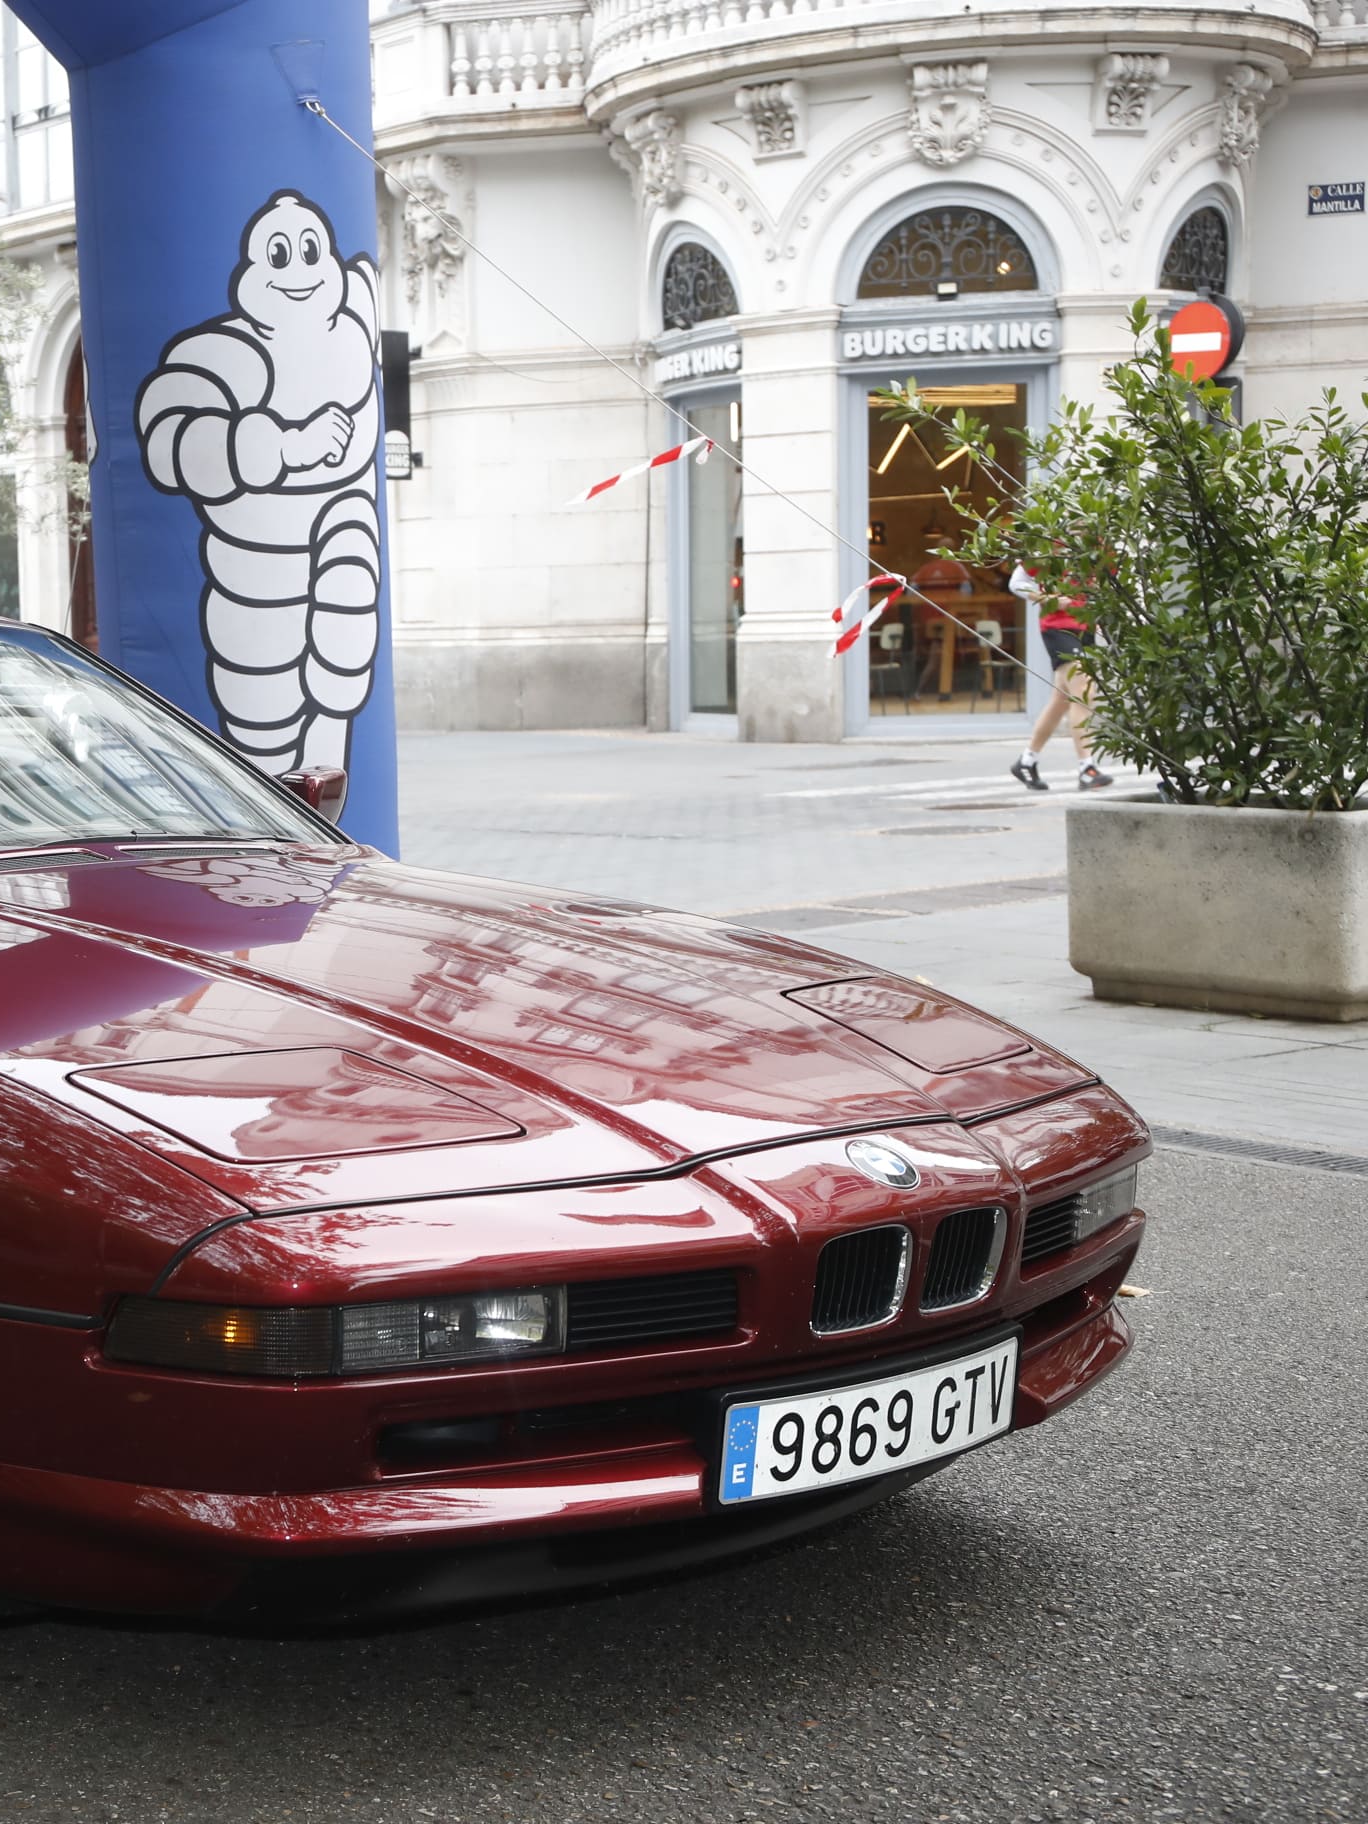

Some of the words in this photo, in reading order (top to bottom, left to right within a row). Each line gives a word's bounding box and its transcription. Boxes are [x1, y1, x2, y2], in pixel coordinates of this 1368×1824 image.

[1327, 183, 1363, 196] CALLE
[1312, 199, 1361, 212] MANTILLA
[843, 324, 968, 358] BURGER
[971, 321, 1053, 350] KING
[692, 343, 739, 375] KING
[770, 1389, 913, 1482] 9869
[931, 1355, 1009, 1444] GTV
[732, 1463, 746, 1484] E
